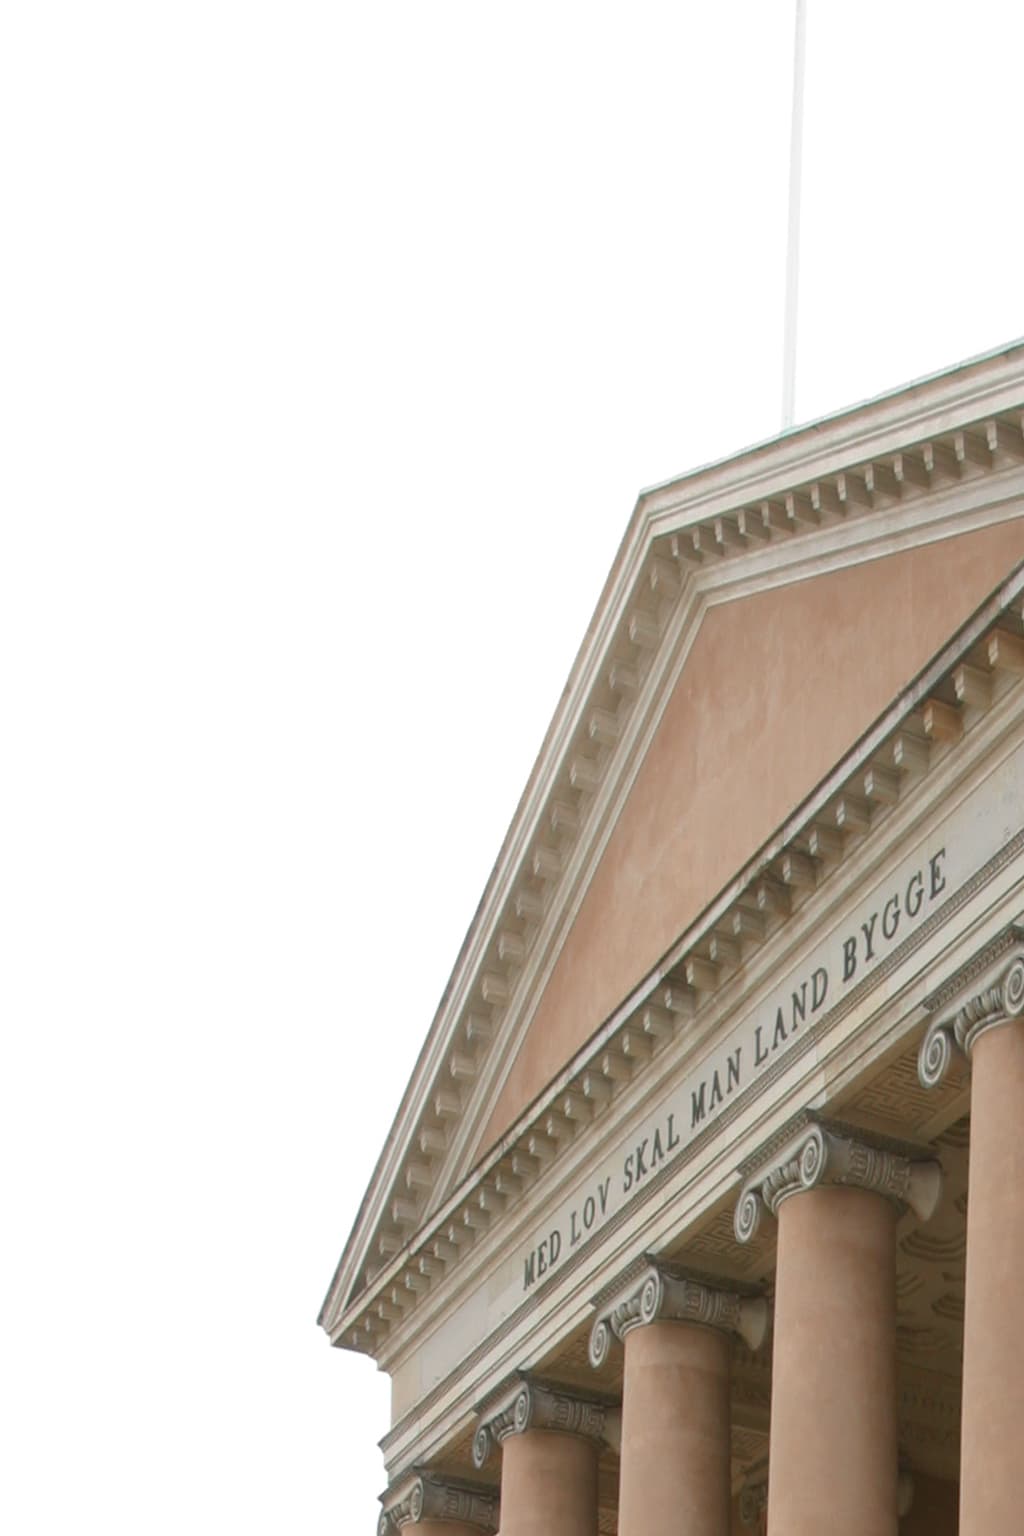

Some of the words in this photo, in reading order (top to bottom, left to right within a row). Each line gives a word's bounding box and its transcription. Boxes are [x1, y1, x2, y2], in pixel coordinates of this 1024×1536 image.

[523, 1229, 562, 1291] MED
[570, 1176, 611, 1247] LOV
[622, 1112, 681, 1194] SKAL
[690, 1048, 743, 1130] MAN
[754, 966, 829, 1067] LAND
[842, 848, 948, 983] BYGGE
